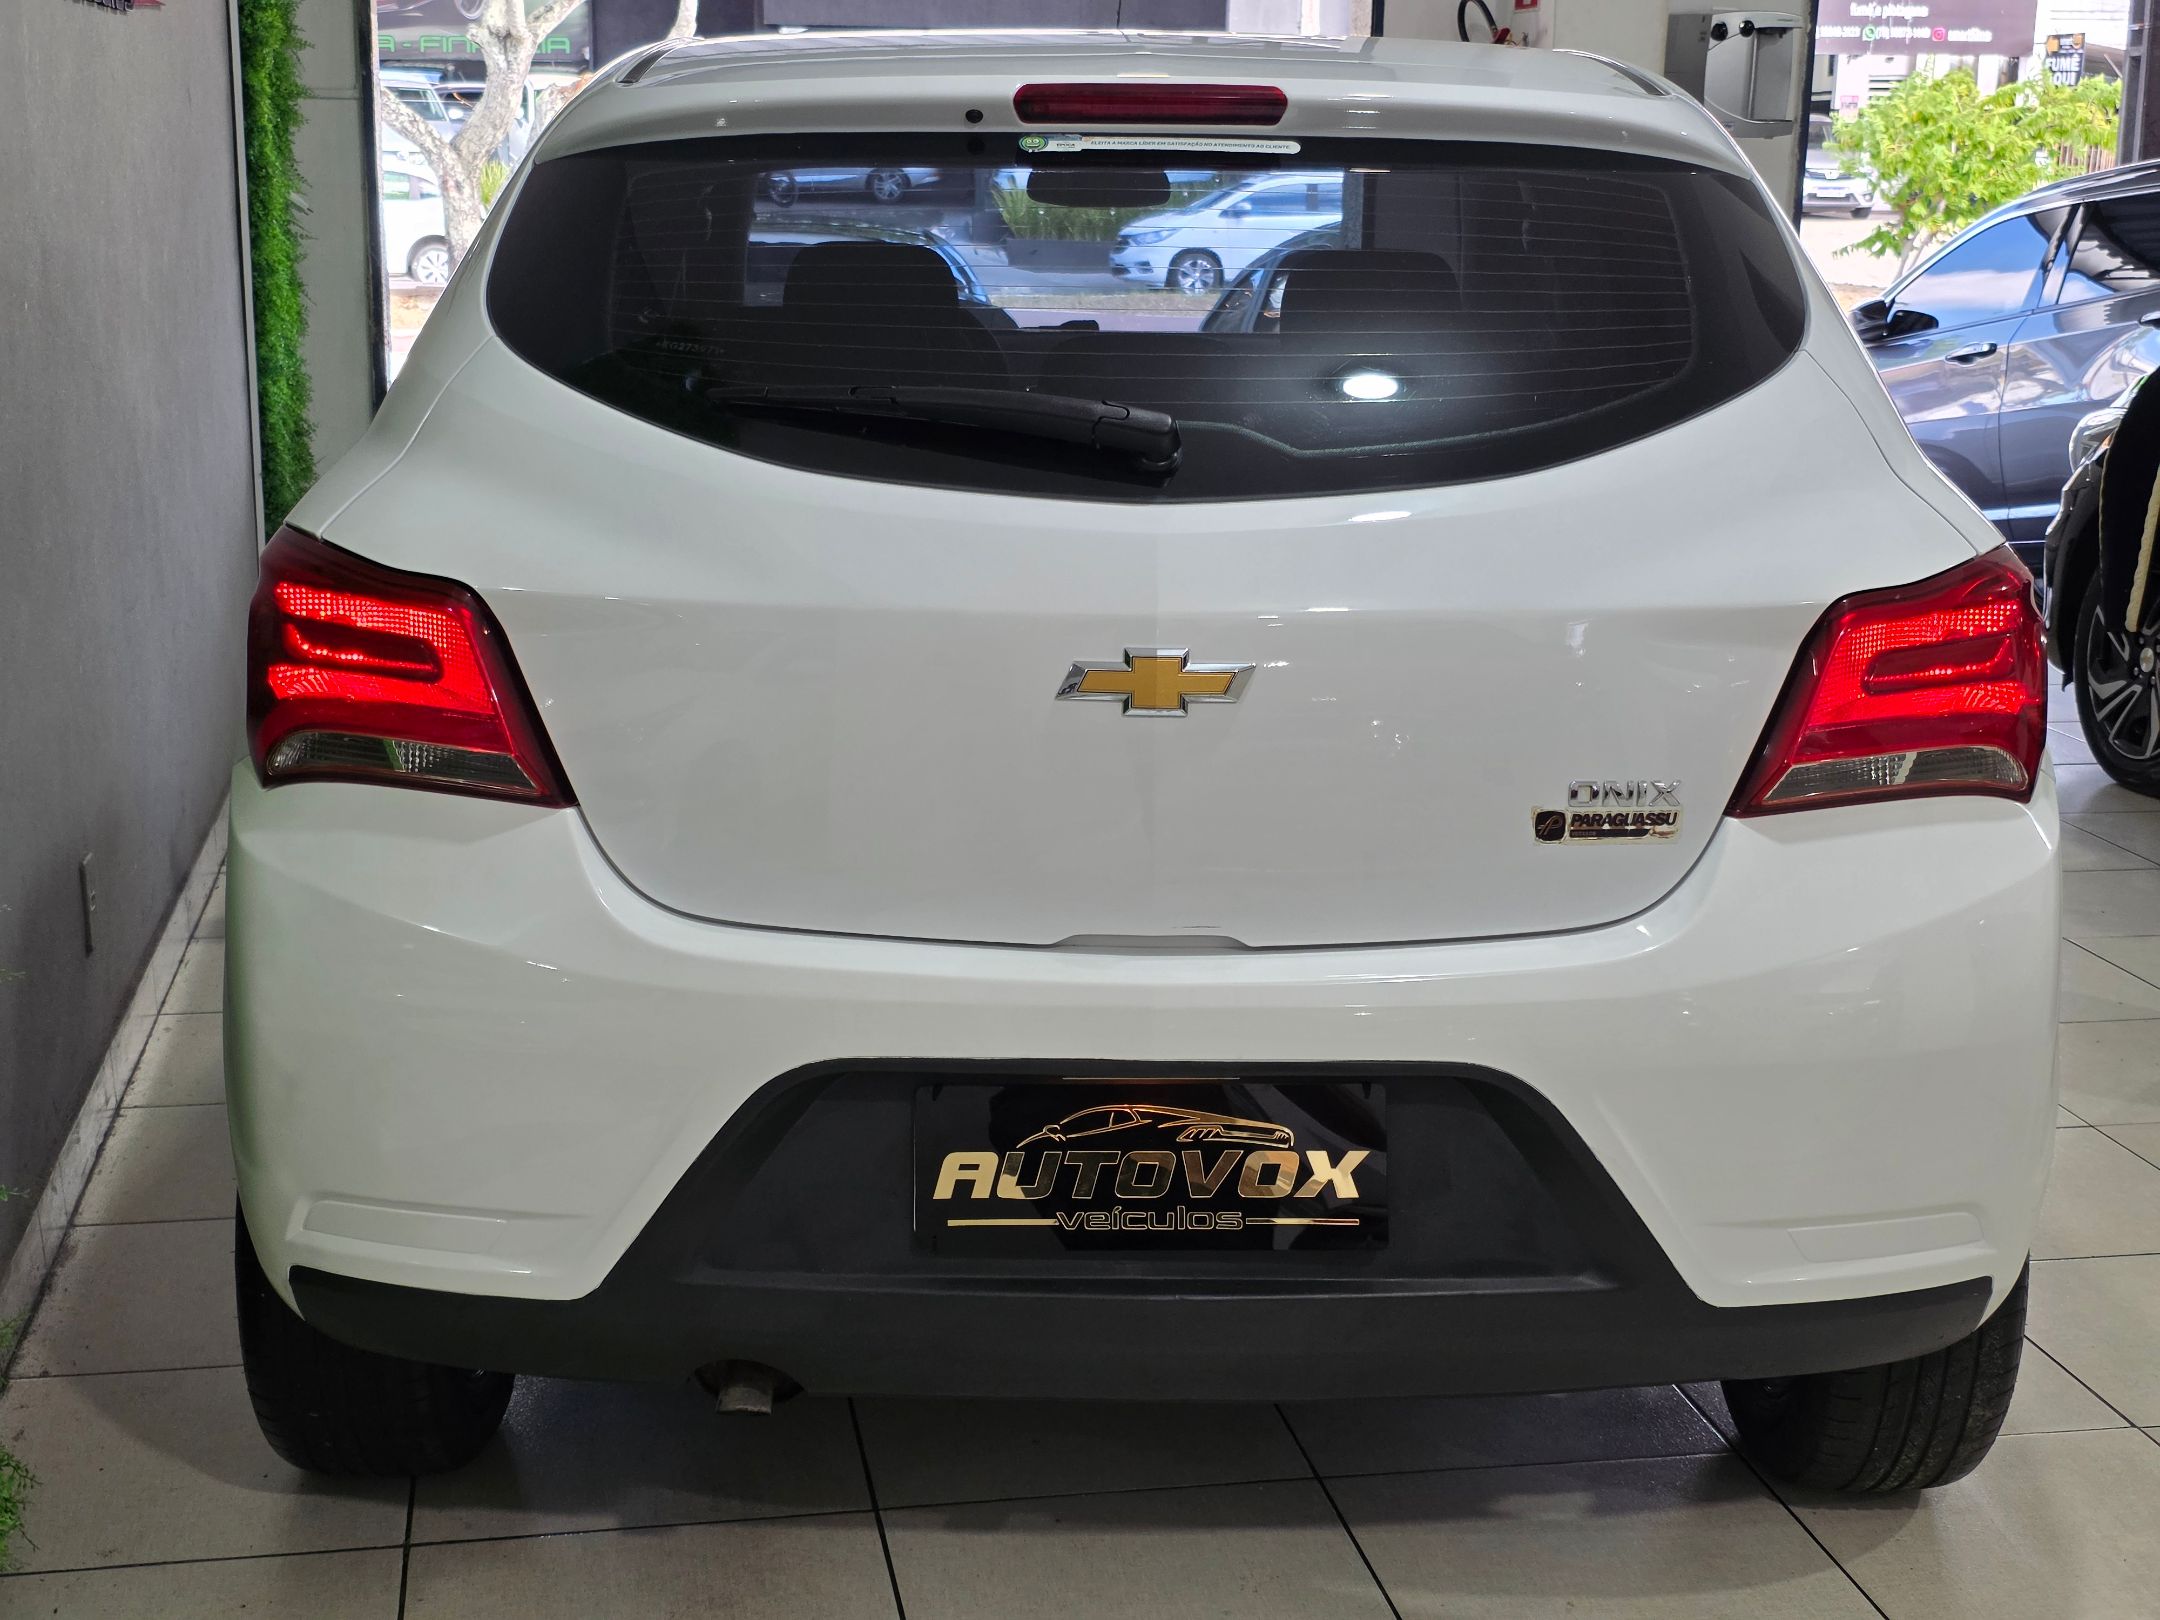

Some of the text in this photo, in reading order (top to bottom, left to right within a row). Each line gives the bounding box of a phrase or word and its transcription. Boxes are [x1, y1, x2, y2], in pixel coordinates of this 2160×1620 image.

[419, 35, 571, 54] FINIA
[1568, 780, 1682, 807] ONIX
[1570, 812, 1678, 827] PARAGUASSU
[932, 1150, 1370, 1199] AUTOVOX
[1055, 1205, 1244, 1230] veículos
